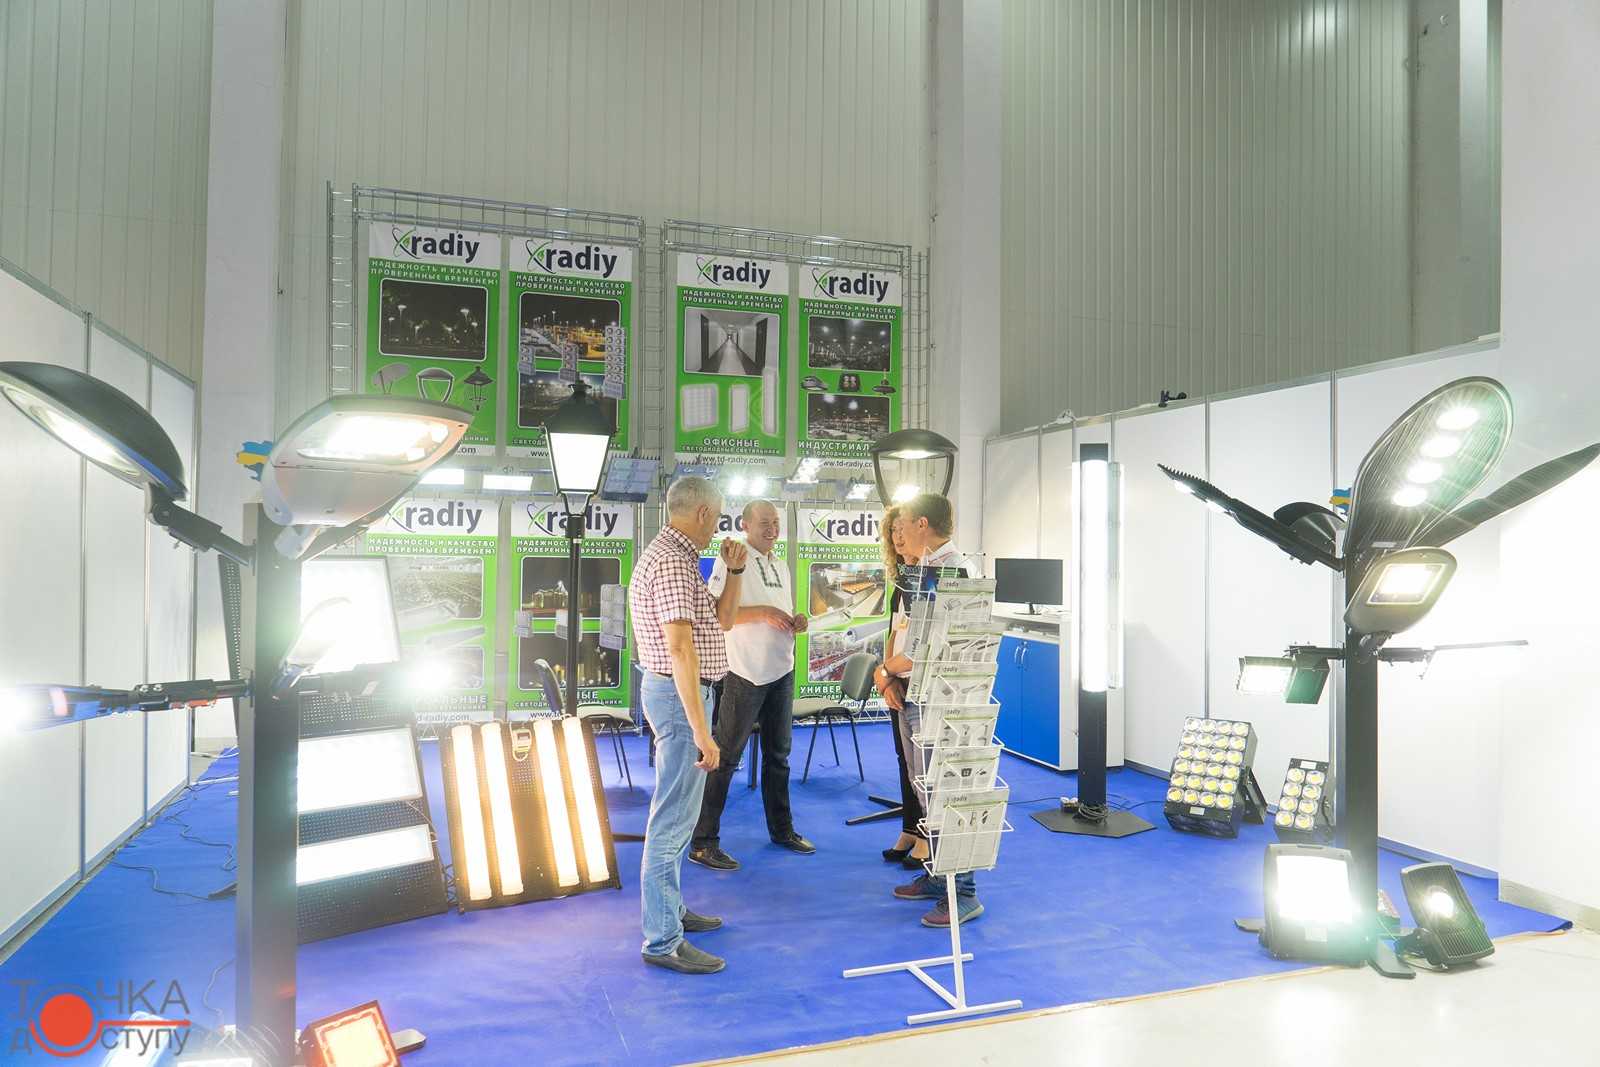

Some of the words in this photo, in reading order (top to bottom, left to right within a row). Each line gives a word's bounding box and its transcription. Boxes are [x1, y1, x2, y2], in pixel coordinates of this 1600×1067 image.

[411, 233, 480, 263] radiy
[546, 246, 617, 278] radiy
[713, 261, 771, 289] radiy
[828, 273, 889, 303] radiy
[703, 438, 760, 447] ОФИСНЫЕ
[798, 441, 870, 451] ИНДУСТРИАЛ
[405, 501, 483, 534] radiy
